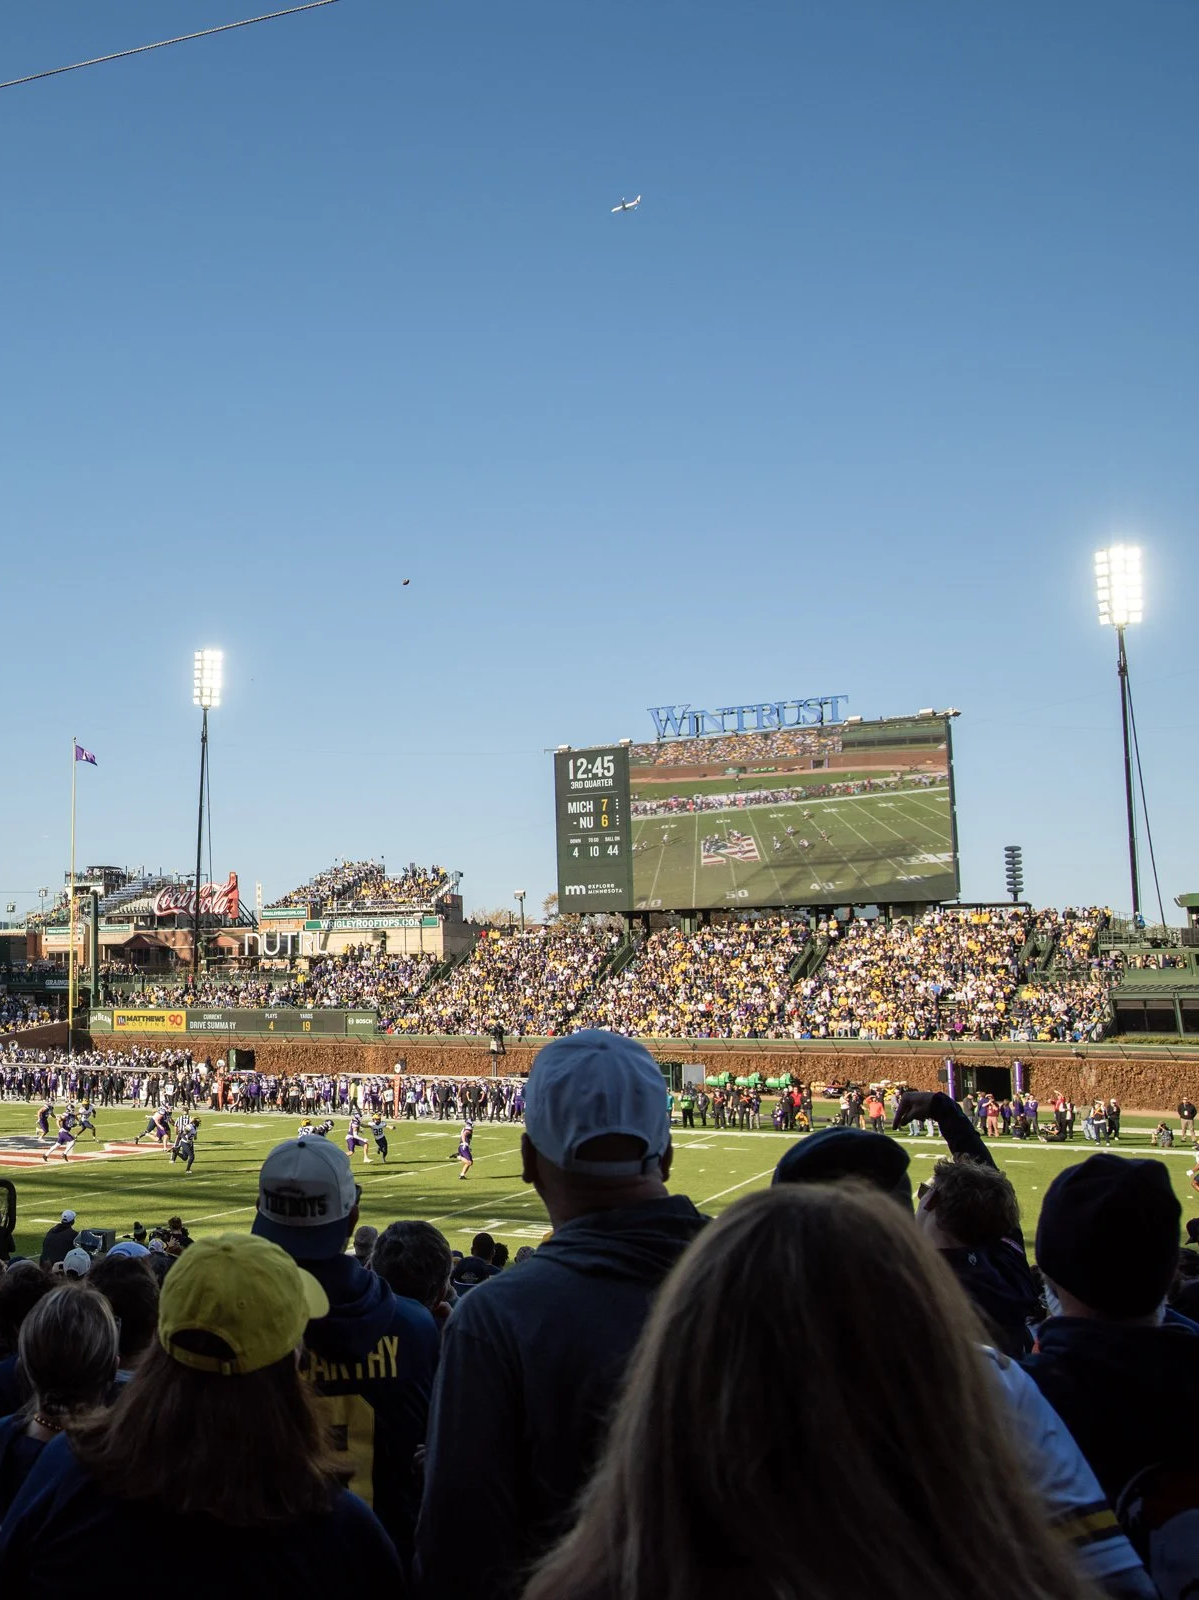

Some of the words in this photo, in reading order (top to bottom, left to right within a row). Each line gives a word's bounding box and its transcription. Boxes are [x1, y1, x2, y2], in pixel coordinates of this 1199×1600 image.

[647, 695, 849, 738] WINTRUST
[568, 755, 615, 780] 12:45
[570, 780, 583, 790] 3RD
[584, 778, 613, 788] QUARTER
[567, 801, 594, 814] MICH
[601, 798, 608, 812] 7
[579, 816, 594, 829] NU
[601, 814, 609, 828] 6
[572, 847, 579, 858] 4
[590, 846, 599, 857] 10
[607, 845, 619, 856] 44
[168, 1014, 183, 1026] 90
[189, 1021, 207, 1029] DRIVE
[268, 1021, 274, 1031] 4
[302, 1021, 311, 1031] 19
